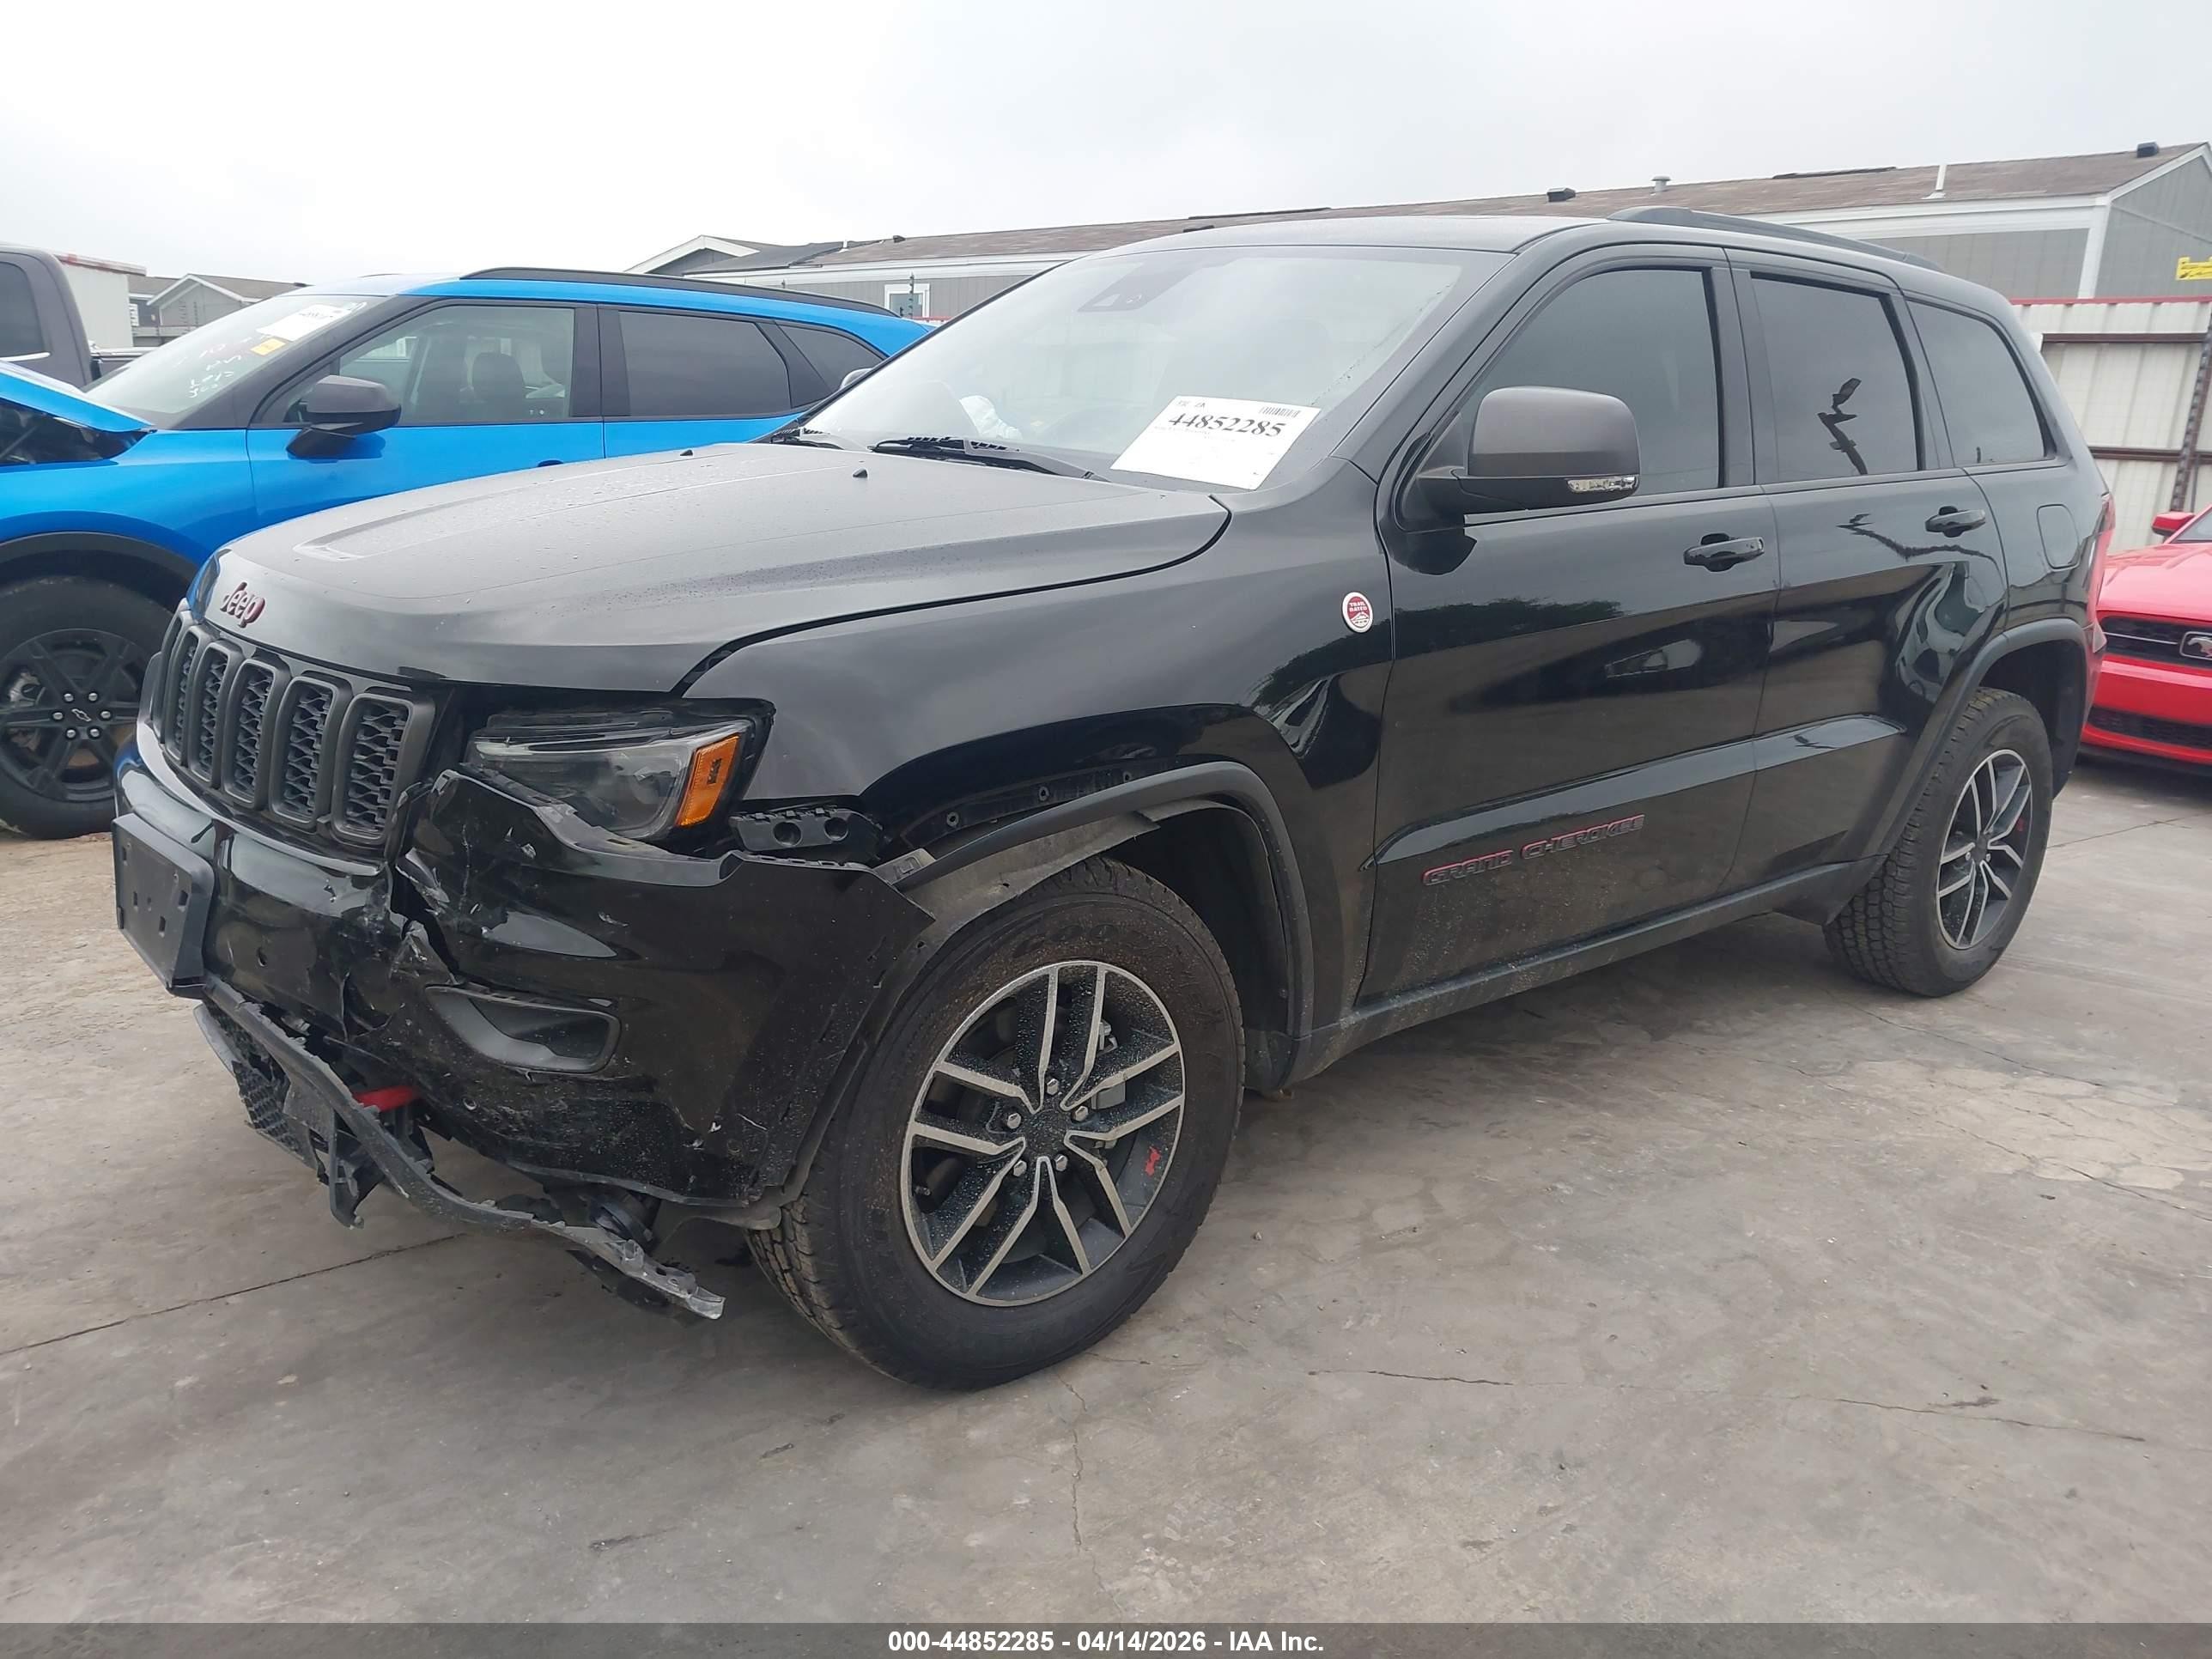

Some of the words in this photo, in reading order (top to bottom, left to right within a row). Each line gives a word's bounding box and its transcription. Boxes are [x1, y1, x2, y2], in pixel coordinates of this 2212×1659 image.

[1168, 412, 1287, 438] 44852285
[220, 581, 266, 629] Jeep
[1423, 849, 1514, 887] GRAND
[1521, 814, 1646, 860] CHEROKEE
